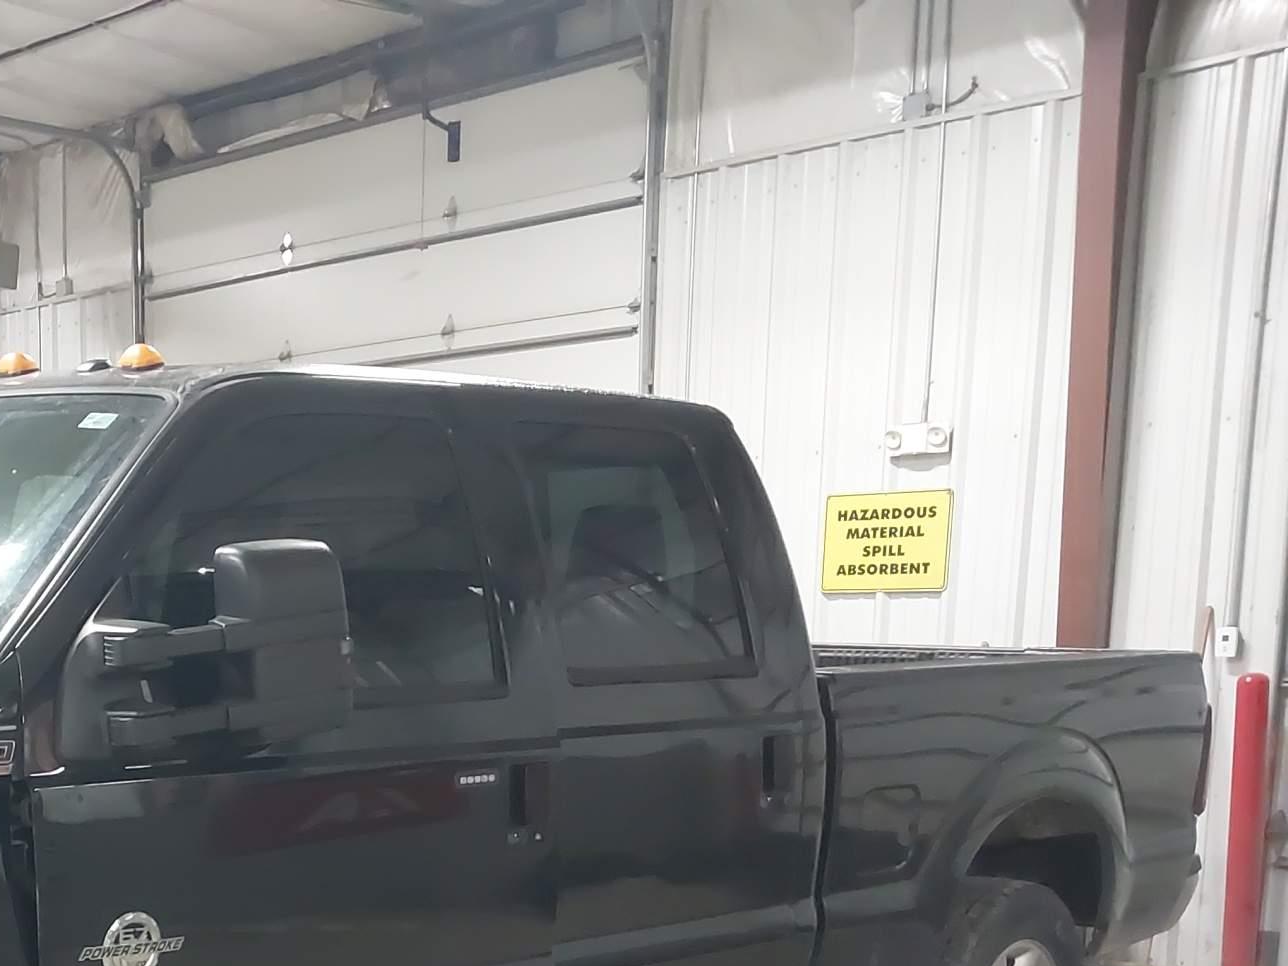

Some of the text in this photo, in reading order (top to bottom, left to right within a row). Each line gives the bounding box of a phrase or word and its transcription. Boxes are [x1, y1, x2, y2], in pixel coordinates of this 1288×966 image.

[837, 506, 937, 521] HAZARDOUS
[846, 525, 925, 540] MATERIAL
[862, 545, 905, 557] SPILL
[836, 562, 930, 576] ABSORBENT
[81, 939, 183, 960] POWER STROKE
